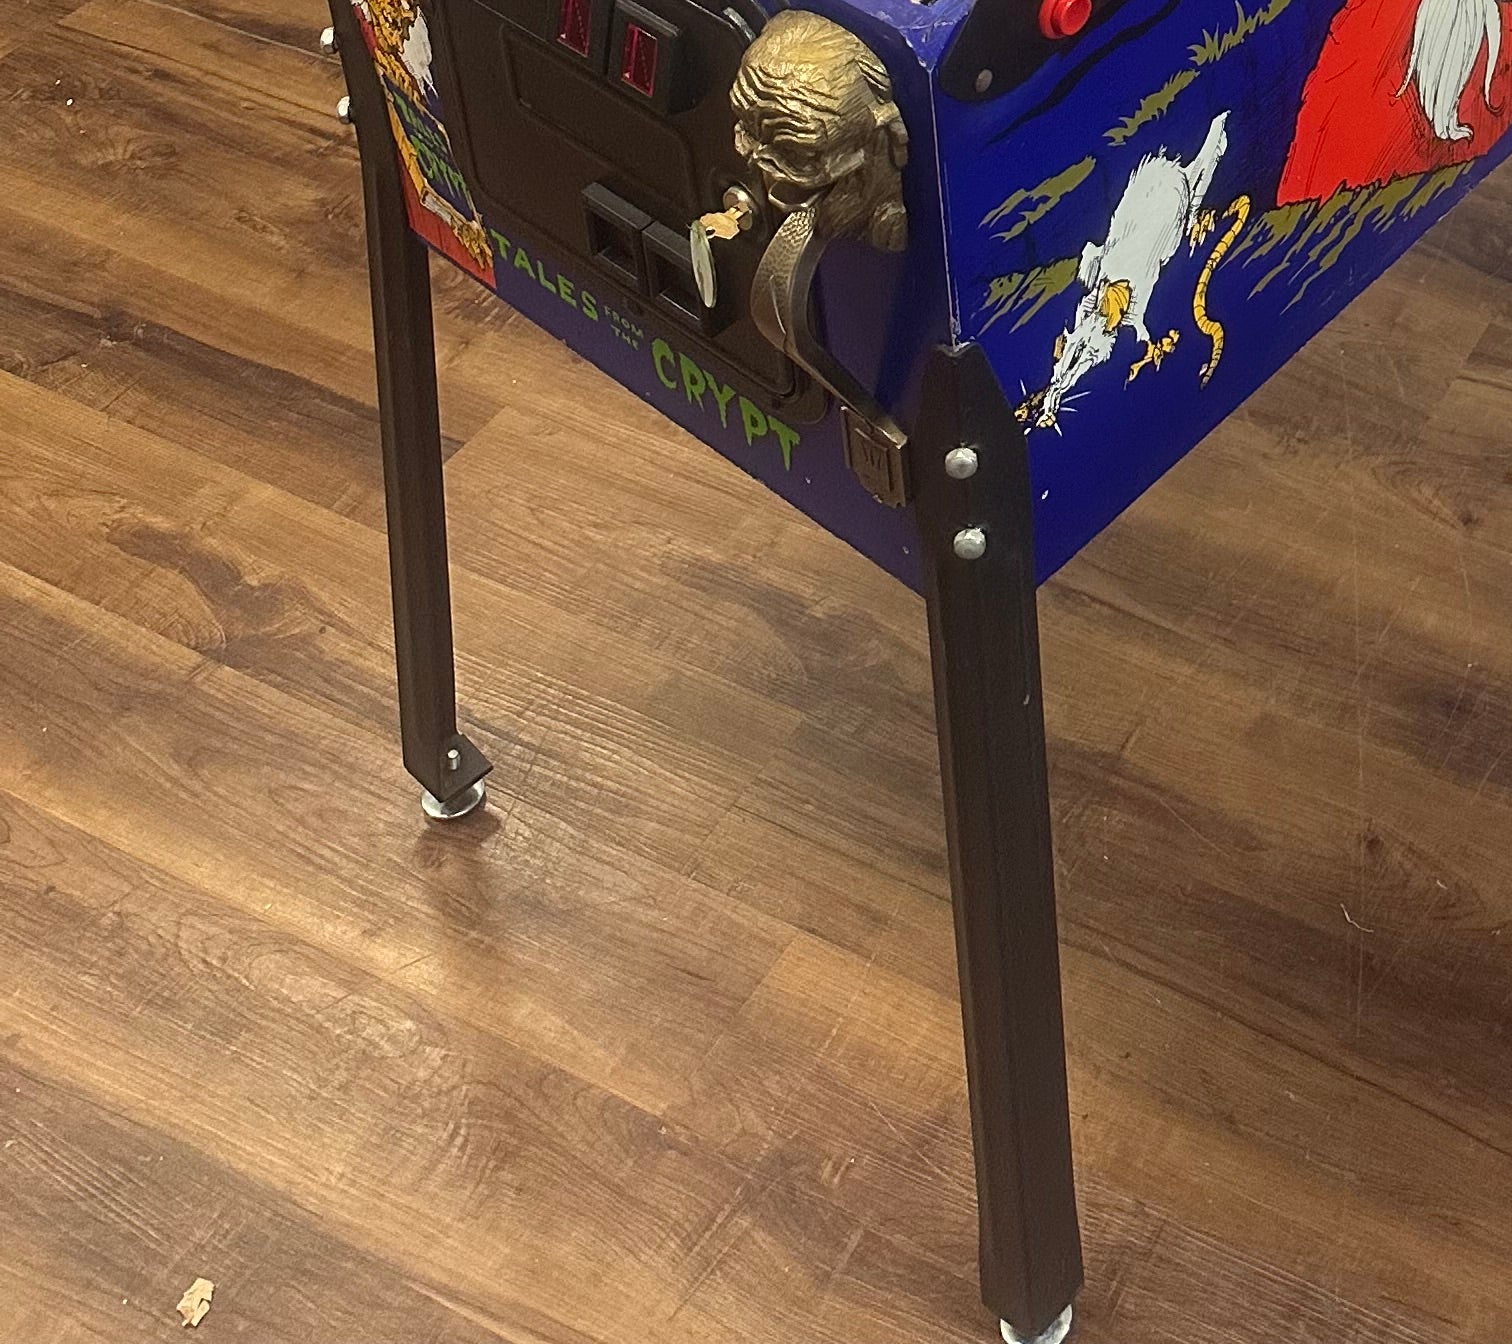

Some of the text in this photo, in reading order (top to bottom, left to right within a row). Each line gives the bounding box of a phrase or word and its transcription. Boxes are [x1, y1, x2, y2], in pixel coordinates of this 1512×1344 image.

[490, 227, 600, 322] TALES
[603, 305, 645, 340] FROM
[610, 323, 640, 352] THE
[651, 337, 801, 472] CRYPT
